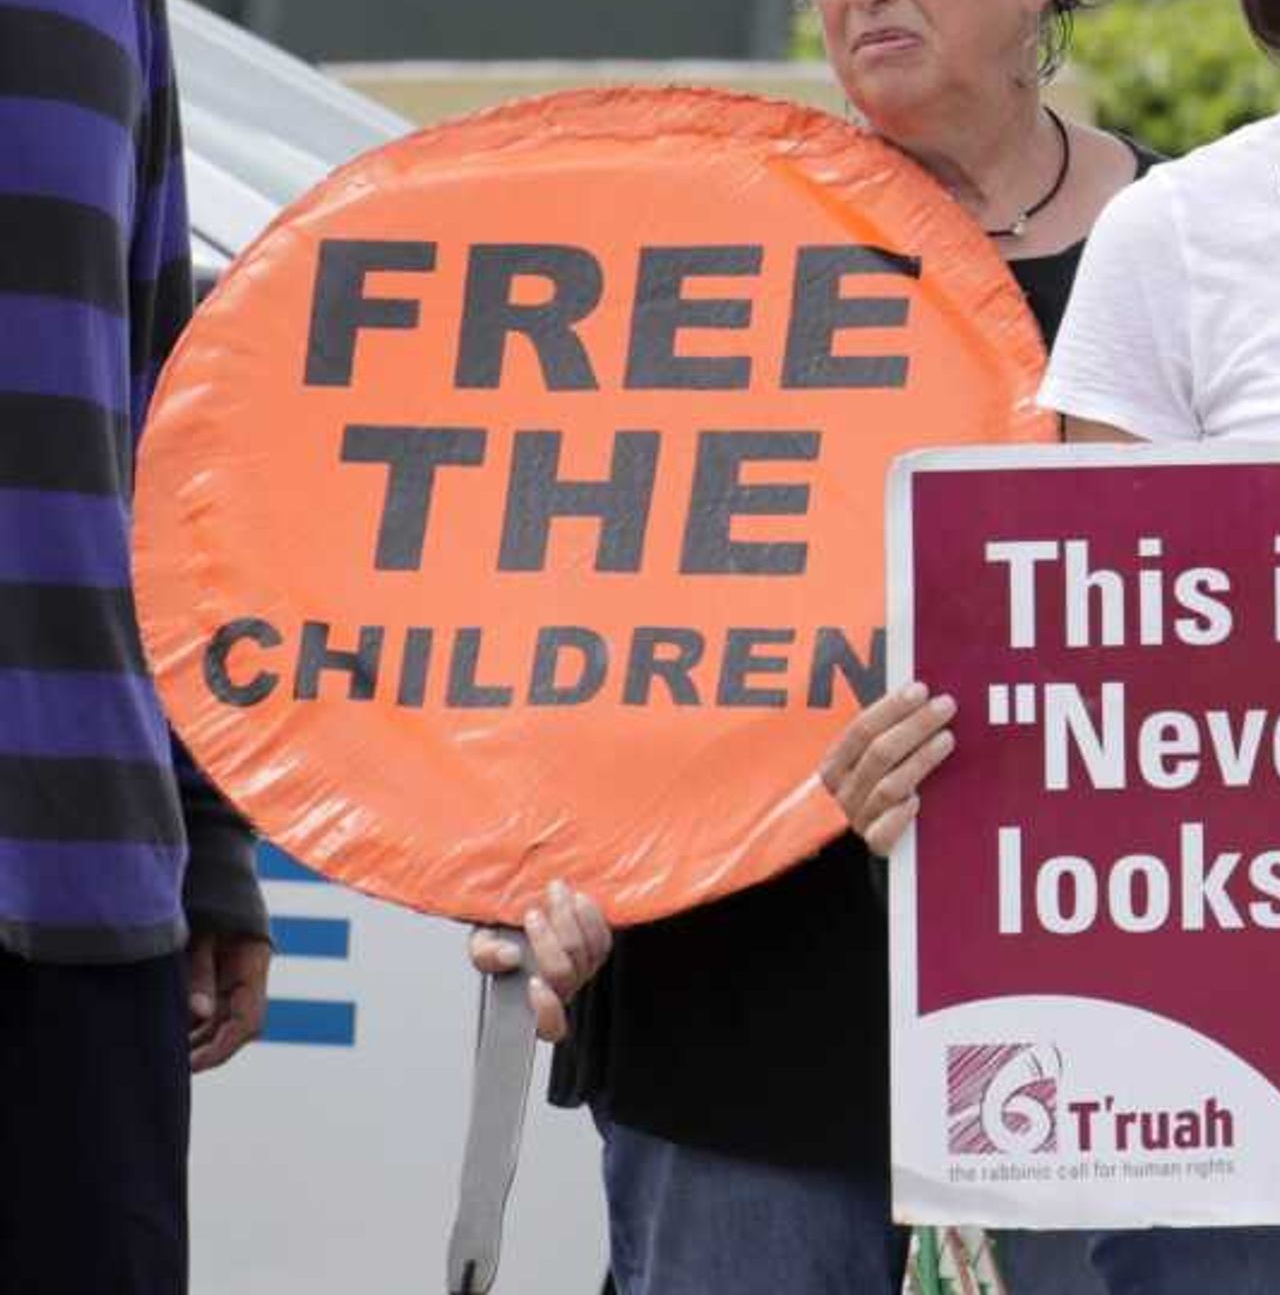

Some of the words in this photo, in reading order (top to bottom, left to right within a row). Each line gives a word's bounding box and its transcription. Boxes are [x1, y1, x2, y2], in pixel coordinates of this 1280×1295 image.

[307, 241, 921, 390] FREE
[343, 426, 819, 574] THE
[987, 539, 1231, 647] This
[204, 619, 886, 708] CHILDREN
[1068, 1096, 1234, 1152] T'ruah
